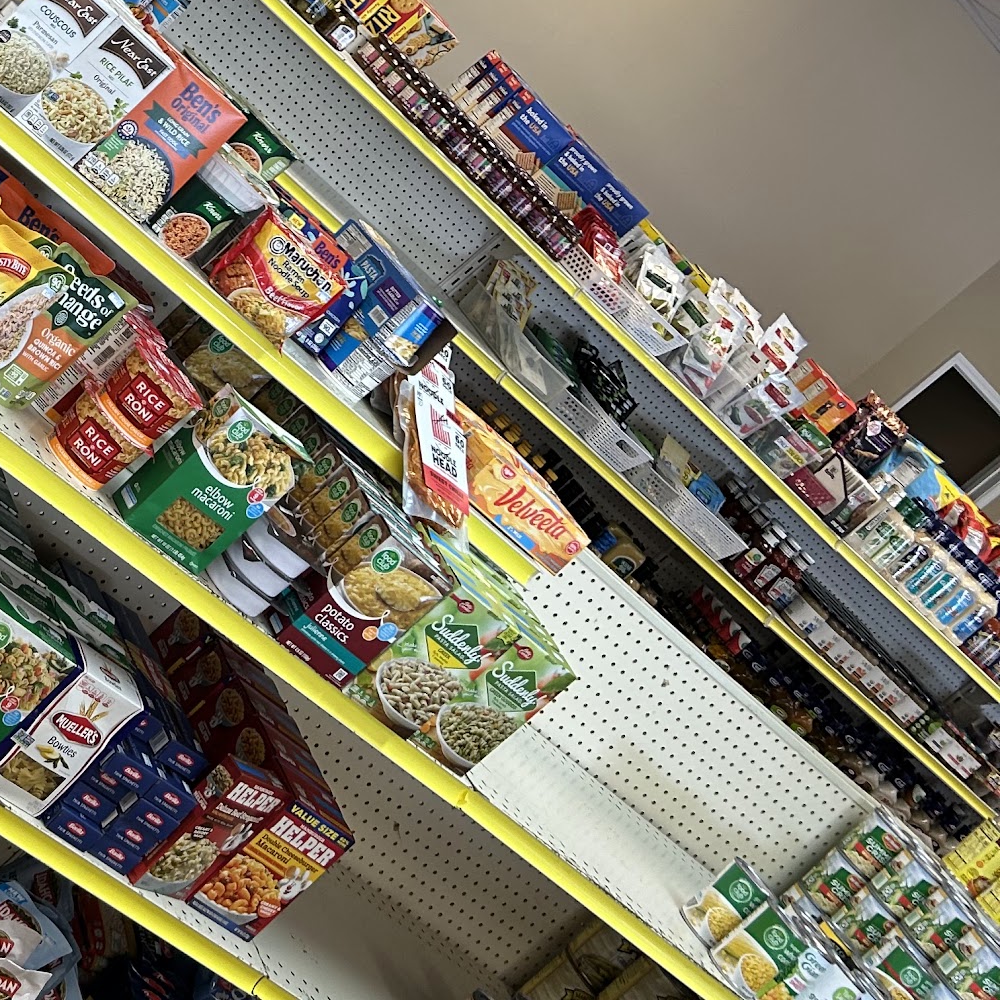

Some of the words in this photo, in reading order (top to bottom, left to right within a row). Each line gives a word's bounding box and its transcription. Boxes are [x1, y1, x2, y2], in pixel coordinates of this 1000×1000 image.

[39, 3, 76, 38] COUSCOUS
[77, 2, 100, 25] East
[362, 0, 403, 42] RITZ
[32, 19, 59, 45] Parmesan
[110, 31, 142, 61] Near
[136, 54, 160, 78] East
[92, 74, 115, 95] Original
[99, 56, 116, 72] RICE
[113, 69, 134, 89] PILAF
[169, 96, 210, 134] Original
[177, 79, 224, 124] Ben's
[525, 106, 542, 123] baked
[162, 121, 177, 136] WILD
[175, 133, 190, 147] RICE
[527, 121, 542, 136] USA
[267, 257, 294, 283] Noodle
[281, 242, 333, 291] Maruchan
[314, 241, 342, 269] Ben's
[282, 259, 306, 284] Ramen
[26, 343, 51, 363] BROWN
[39, 326, 77, 358] Organic
[122, 391, 154, 422] RONI
[133, 380, 166, 412] RICE
[71, 436, 103, 467] RONI
[82, 425, 115, 456] RICE
[429, 451, 460, 480] HEAD
[191, 485, 232, 521] macaroni
[205, 482, 234, 510] elbow
[493, 476, 574, 546] Velveeta
[303, 620, 328, 642] julienne
[313, 610, 350, 643] classics
[322, 601, 355, 632] potato
[54, 711, 99, 746] MUELLER'S
[46, 734, 78, 759] Bowties
[225, 773, 282, 824] HELPER
[289, 803, 320, 828] VALUE
[317, 822, 339, 841] SIZE
[254, 837, 291, 865] Macaroni
[261, 832, 283, 850] Double
[279, 845, 320, 875] Cheeseburger
[268, 812, 338, 868] HELPER
[864, 836, 896, 865] SUMM
[803, 950, 828, 974] Gree
